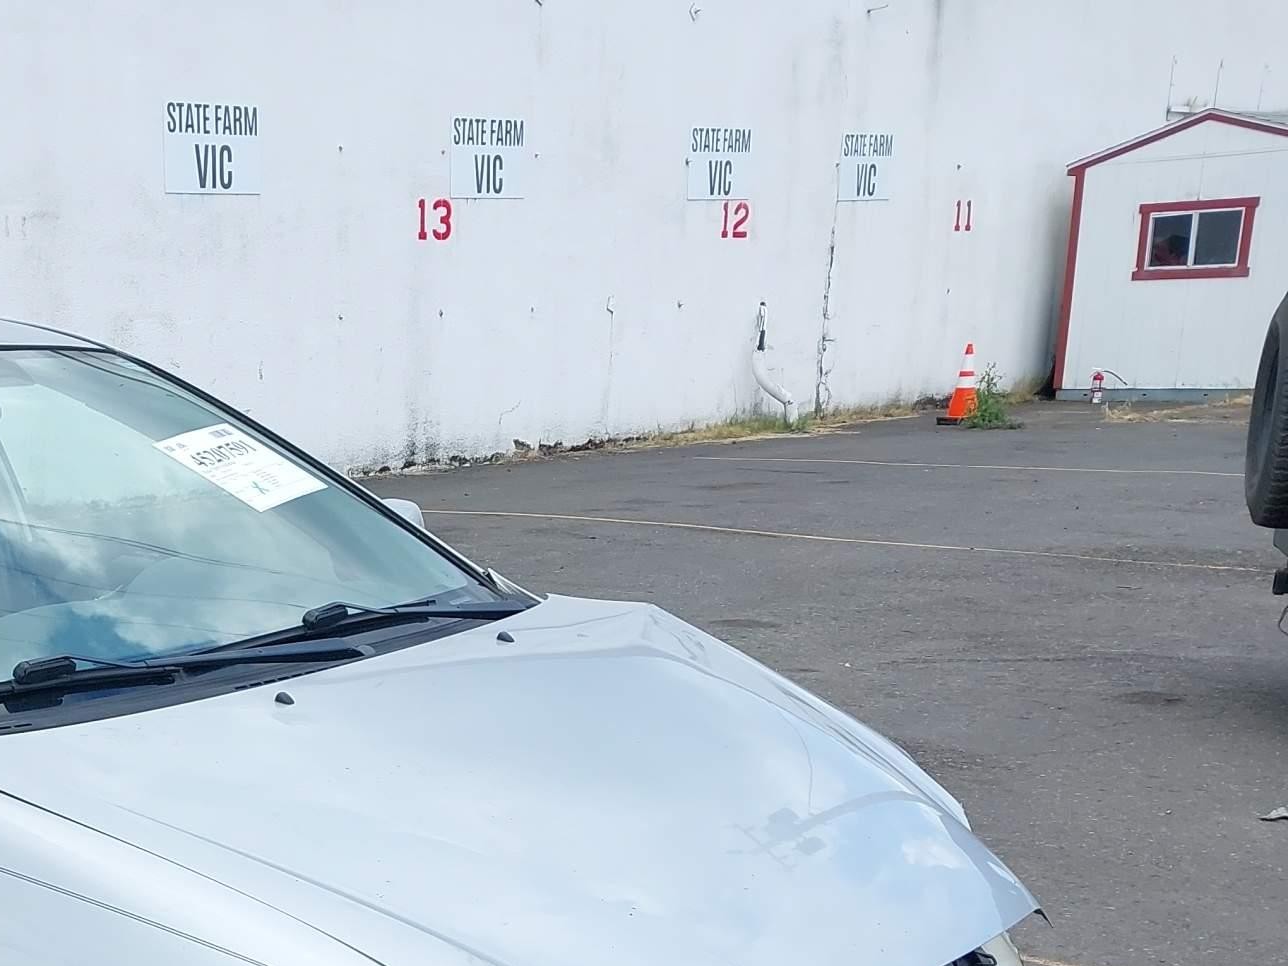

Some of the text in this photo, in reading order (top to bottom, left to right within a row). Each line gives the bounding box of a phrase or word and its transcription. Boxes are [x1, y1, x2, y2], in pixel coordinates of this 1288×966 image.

[167, 102, 258, 136] STATE FARM
[453, 118, 524, 146] STATE FARM
[692, 128, 751, 153] STATE FARM
[843, 134, 893, 157] STATE FARM
[194, 144, 232, 190] VIC
[474, 154, 503, 194] VIC
[708, 160, 733, 196] VIC
[856, 163, 877, 197] VIC
[418, 198, 452, 240] 13
[721, 202, 750, 238] 12
[954, 200, 972, 231] 11
[190, 440, 257, 468] 45207591
